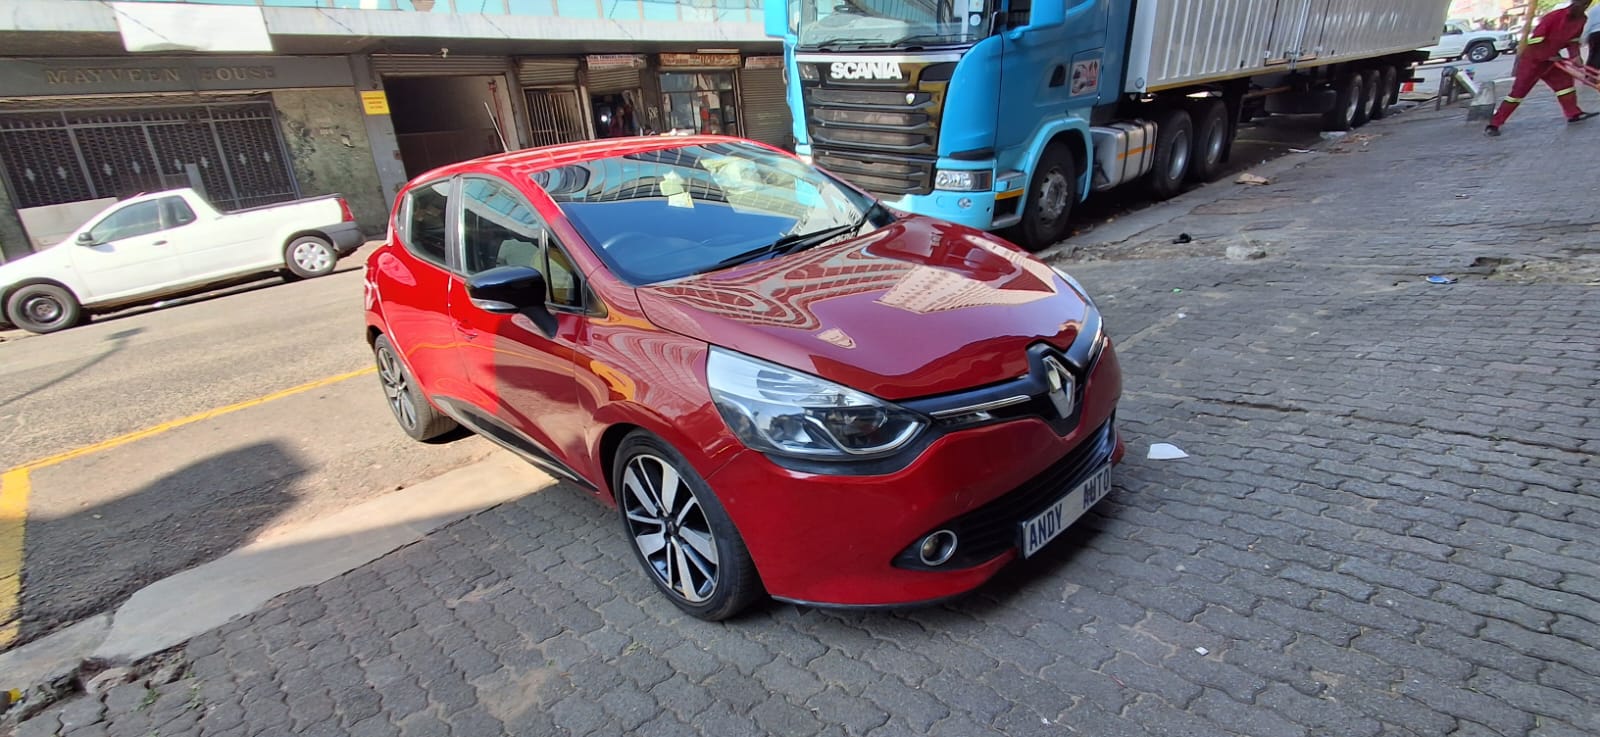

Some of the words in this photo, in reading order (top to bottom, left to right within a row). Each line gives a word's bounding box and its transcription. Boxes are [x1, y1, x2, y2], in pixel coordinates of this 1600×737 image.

[45, 68, 181, 86] MAYVEEN
[830, 62, 903, 80] SCANIA
[1029, 503, 1063, 552] ANDY
[1082, 468, 1110, 510] AUTO
